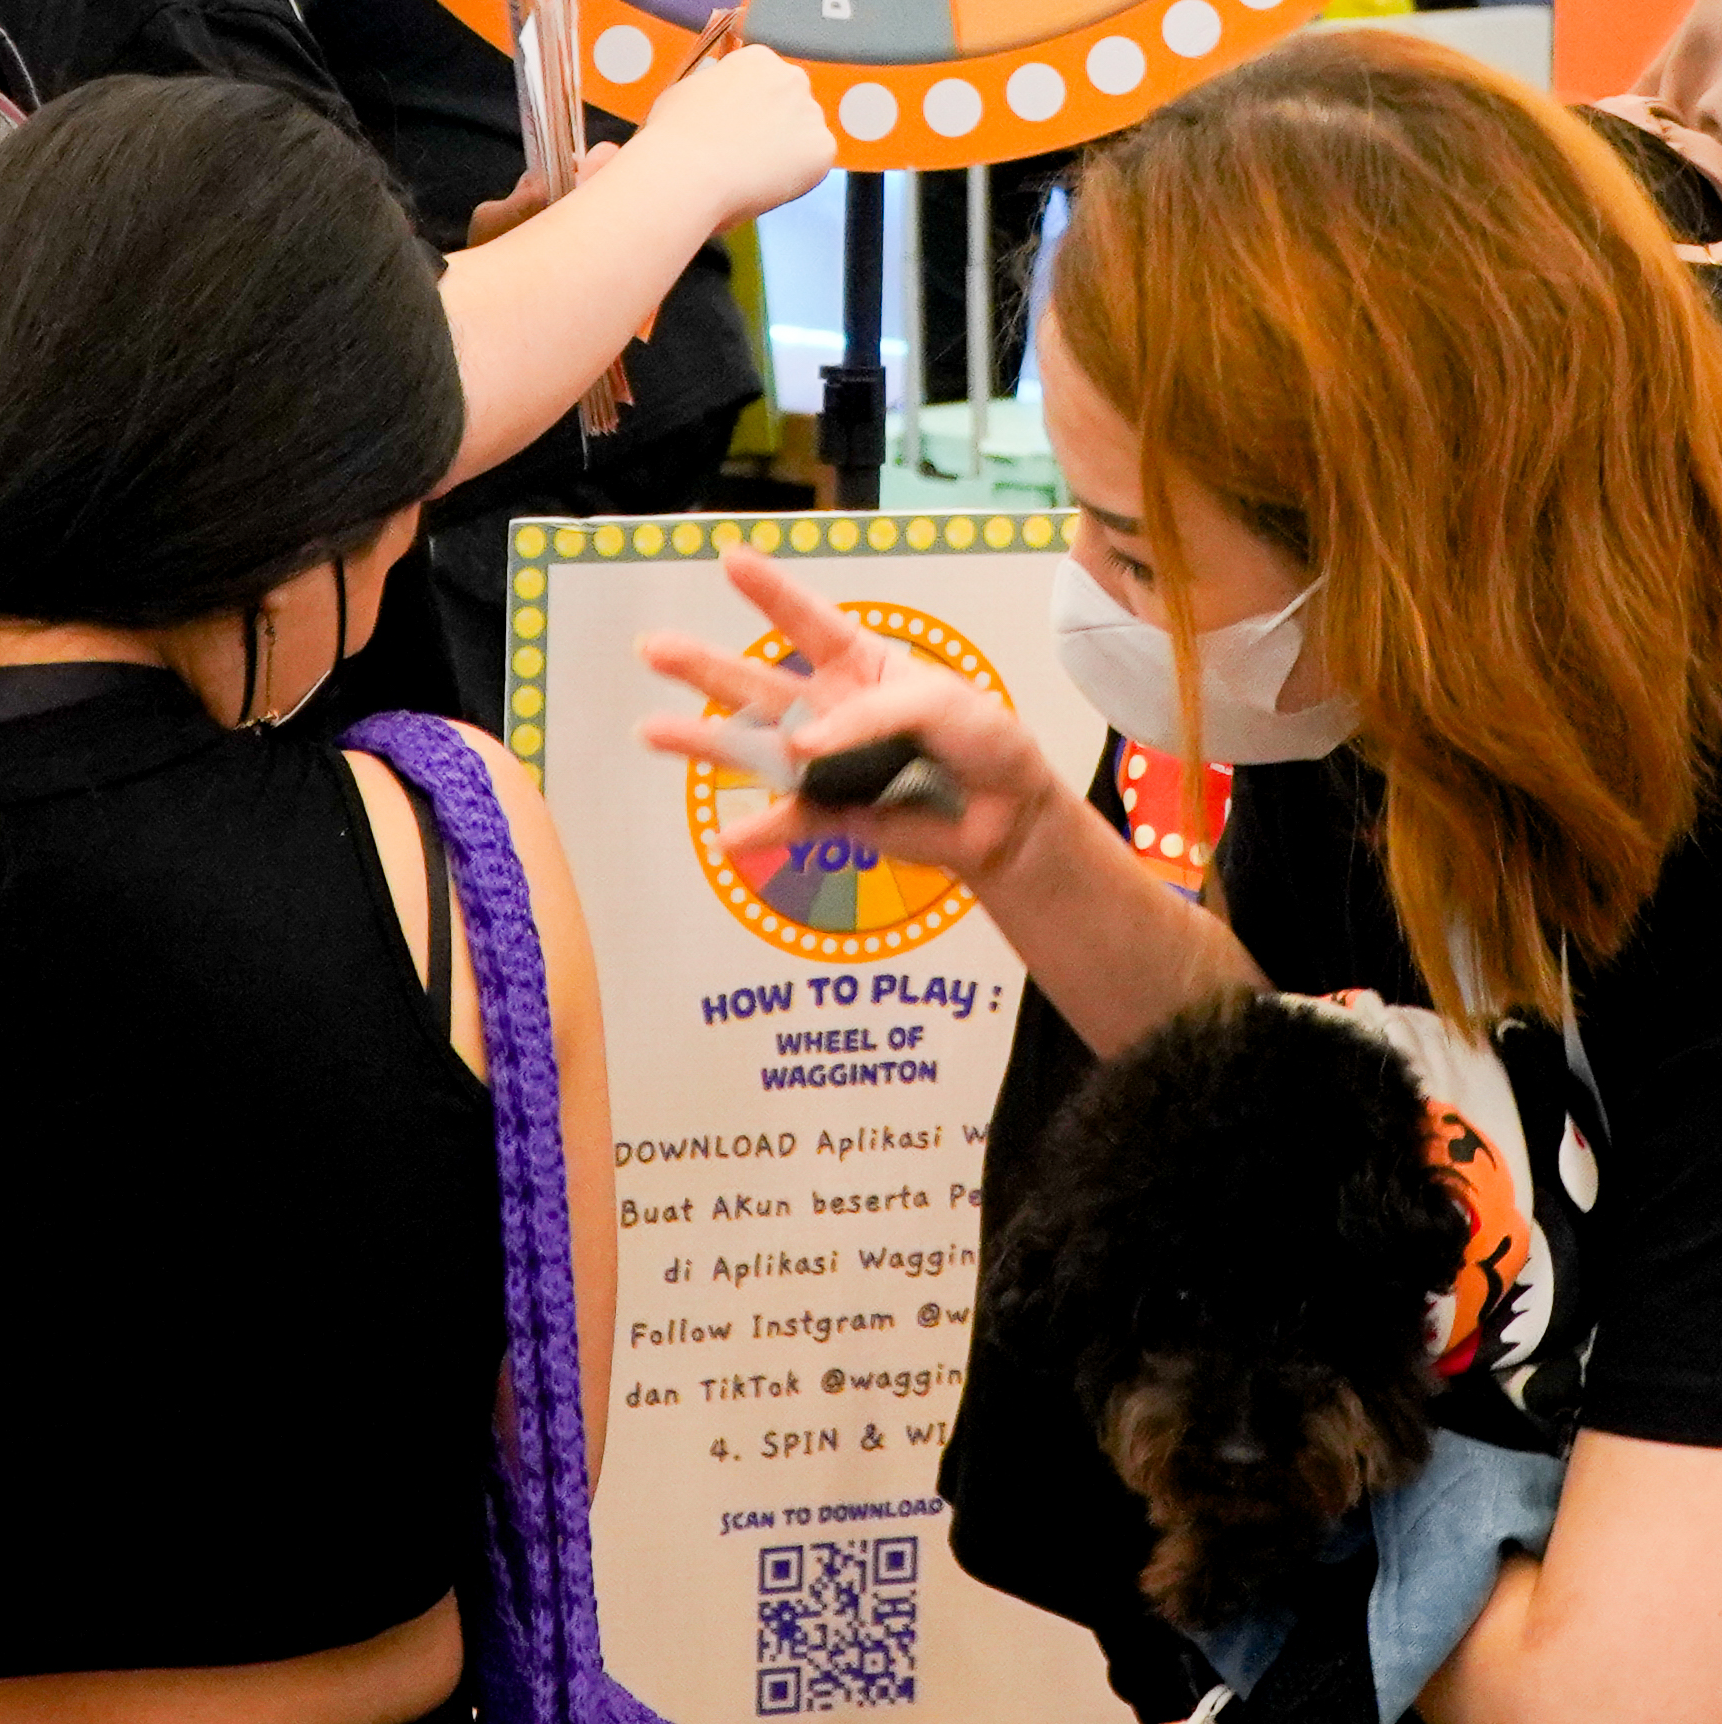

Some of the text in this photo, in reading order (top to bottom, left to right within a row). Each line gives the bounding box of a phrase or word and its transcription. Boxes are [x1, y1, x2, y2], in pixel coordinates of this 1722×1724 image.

[700, 981, 795, 1027] HOW
[807, 974, 860, 1008] TO
[870, 973, 979, 1020] PLAY
[775, 1024, 926, 1056] WHEEL OF
[760, 1060, 939, 1091] WAGGINTON
[615, 1131, 796, 1168] DOWNLOAD
[815, 1124, 944, 1162] Aplikasi
[620, 1196, 695, 1229] Buat
[812, 1183, 931, 1216] beserta
[949, 1182, 983, 1211] Pe
[663, 1242, 977, 1290] di Aplikasi Waggin
[630, 1318, 734, 1349] Follow
[751, 1308, 897, 1345] Instgram
[626, 1362, 965, 1410] dan TikTok @waggin
[708, 1422, 949, 1463] 4. SPIN & WI
[720, 1498, 945, 1536] SCAN TO DOWNLOAD
